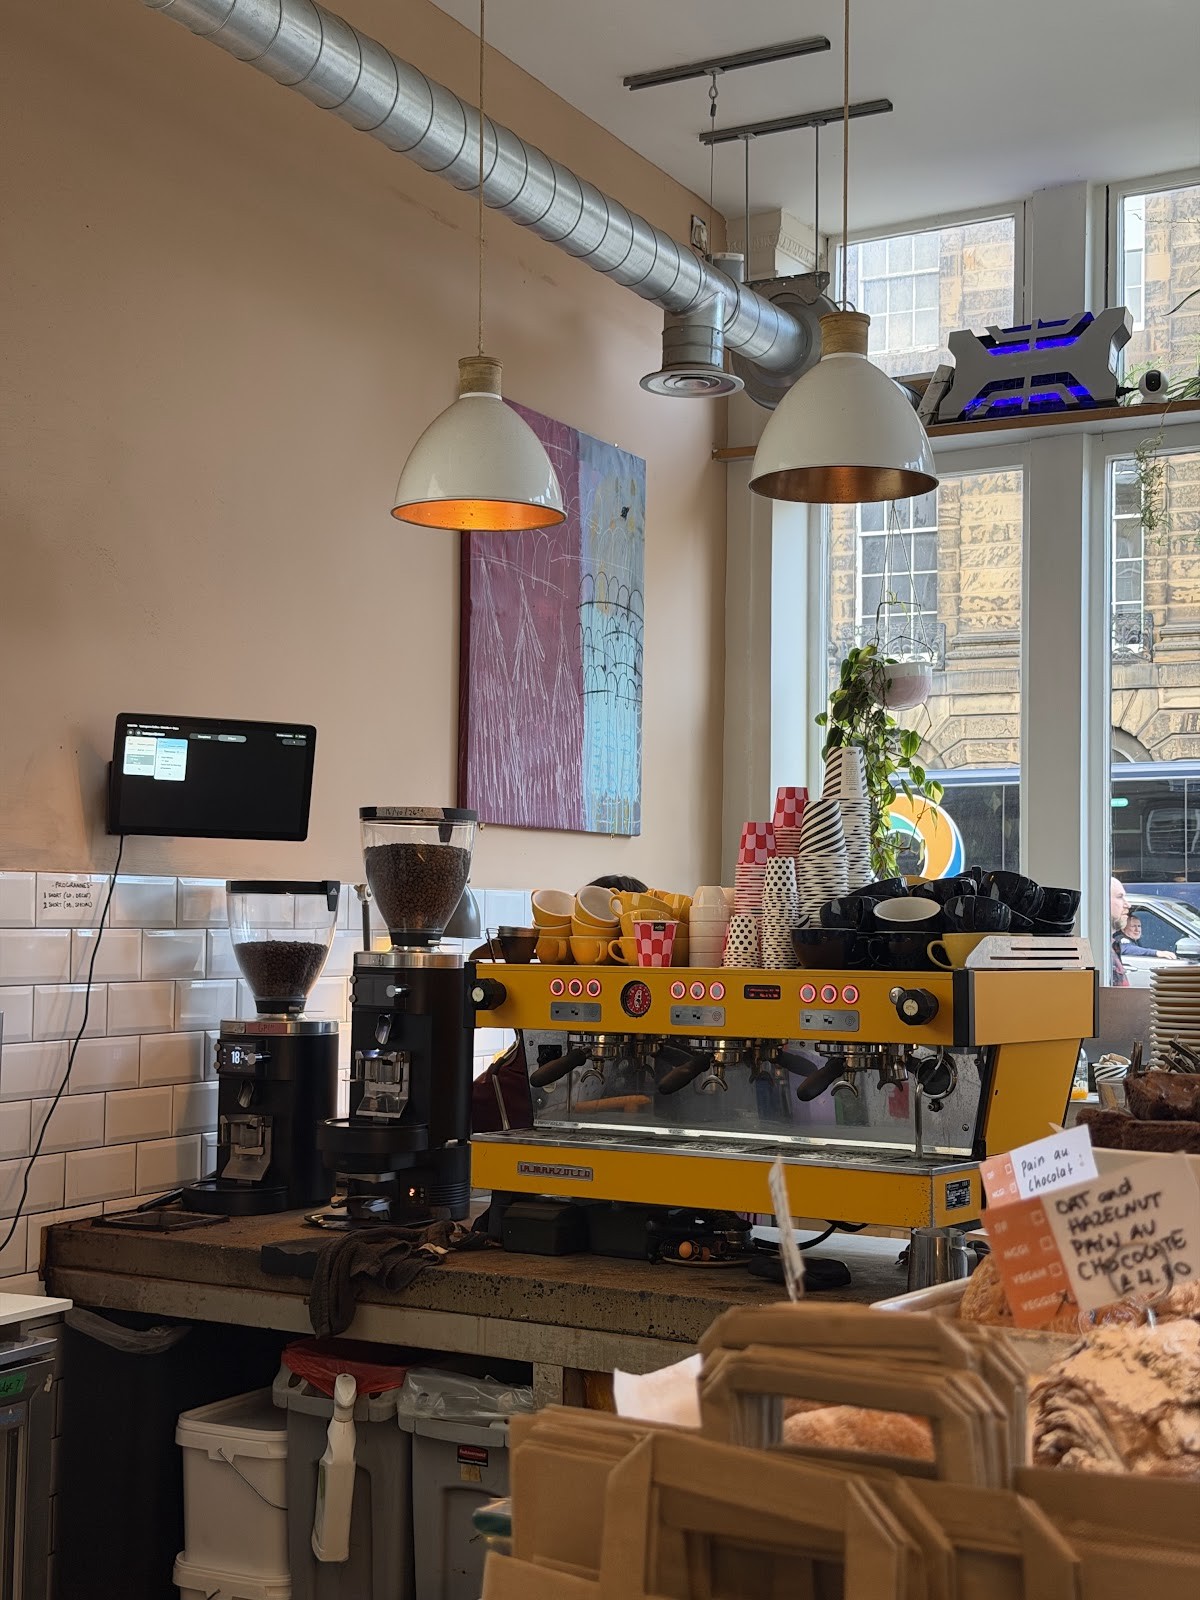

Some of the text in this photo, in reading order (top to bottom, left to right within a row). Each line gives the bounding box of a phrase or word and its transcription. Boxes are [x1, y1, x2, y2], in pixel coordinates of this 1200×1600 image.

[231, 1050, 241, 1064] 18
[1021, 1147, 1069, 1177] Pain au
[409, 1188, 416, 1197] 2
[1055, 1177, 1132, 1215] OAT and
[1068, 1191, 1162, 1235] HAZELNUT
[1130, 1219, 1156, 1240] AU
[1012, 1267, 1047, 1284] VEGAN
